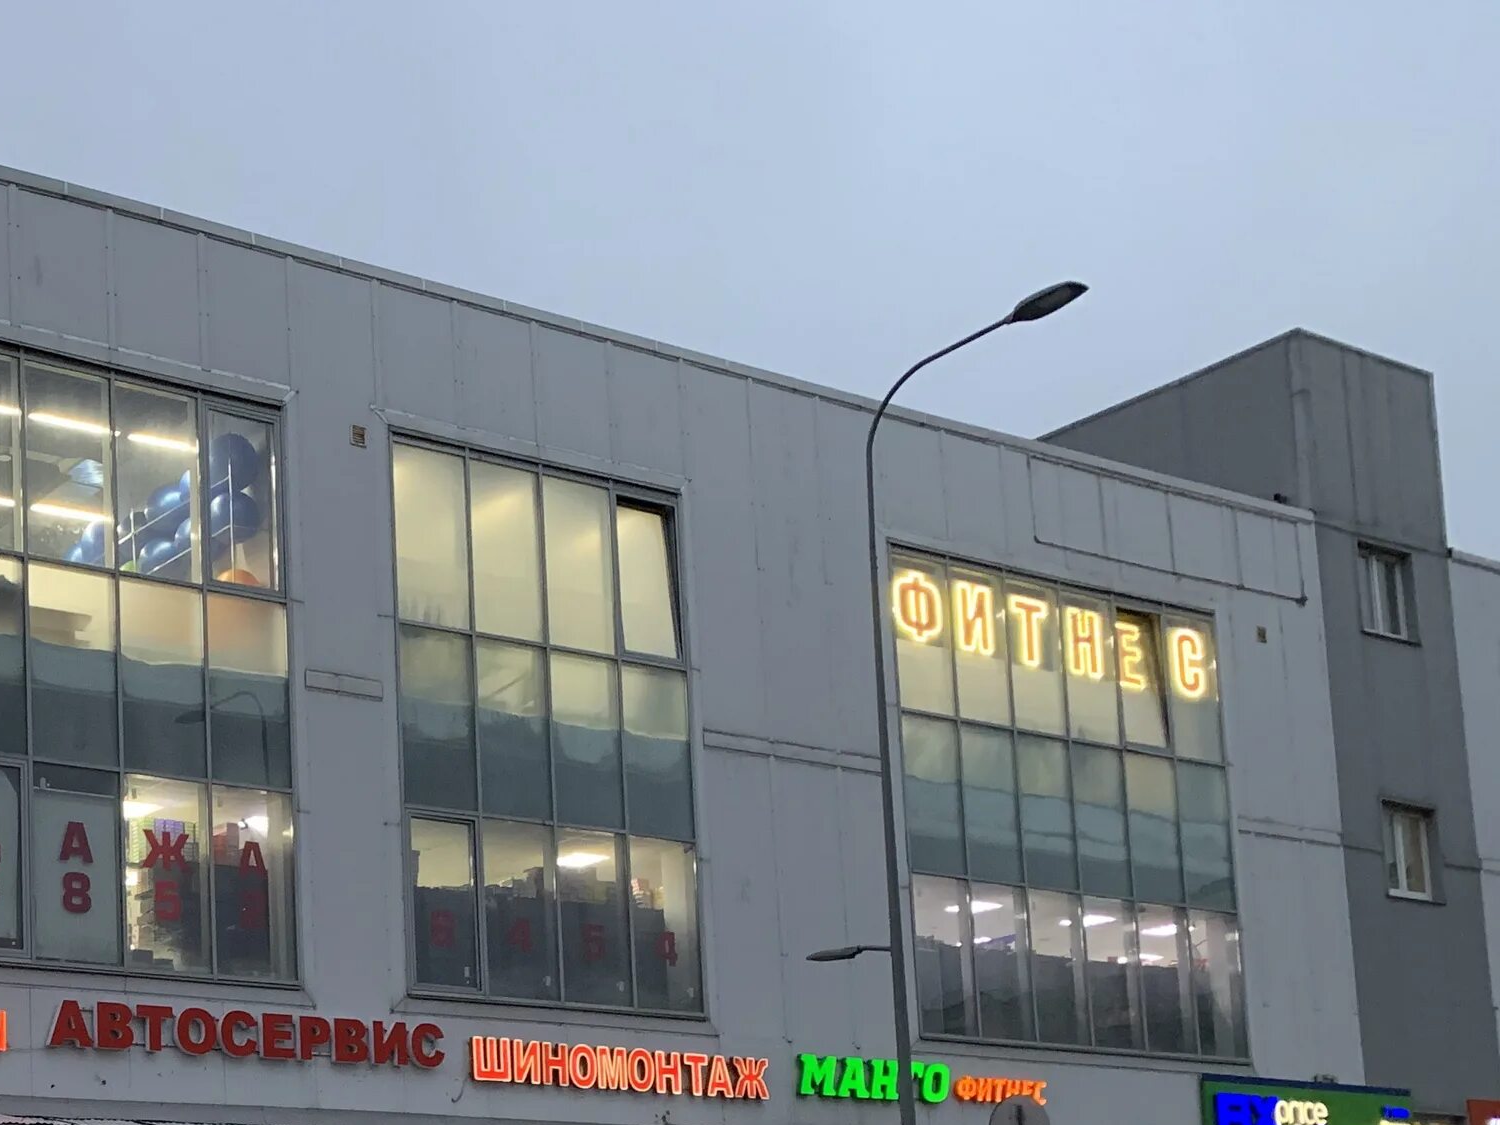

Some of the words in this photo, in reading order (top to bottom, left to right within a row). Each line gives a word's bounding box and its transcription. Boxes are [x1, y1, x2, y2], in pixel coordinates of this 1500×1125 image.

[892, 569, 1206, 699] ФИТНЕС
[46, 999, 445, 1069] АВТОСЕРВИС
[471, 1036, 769, 1100] ШИНОМОНТАЖ
